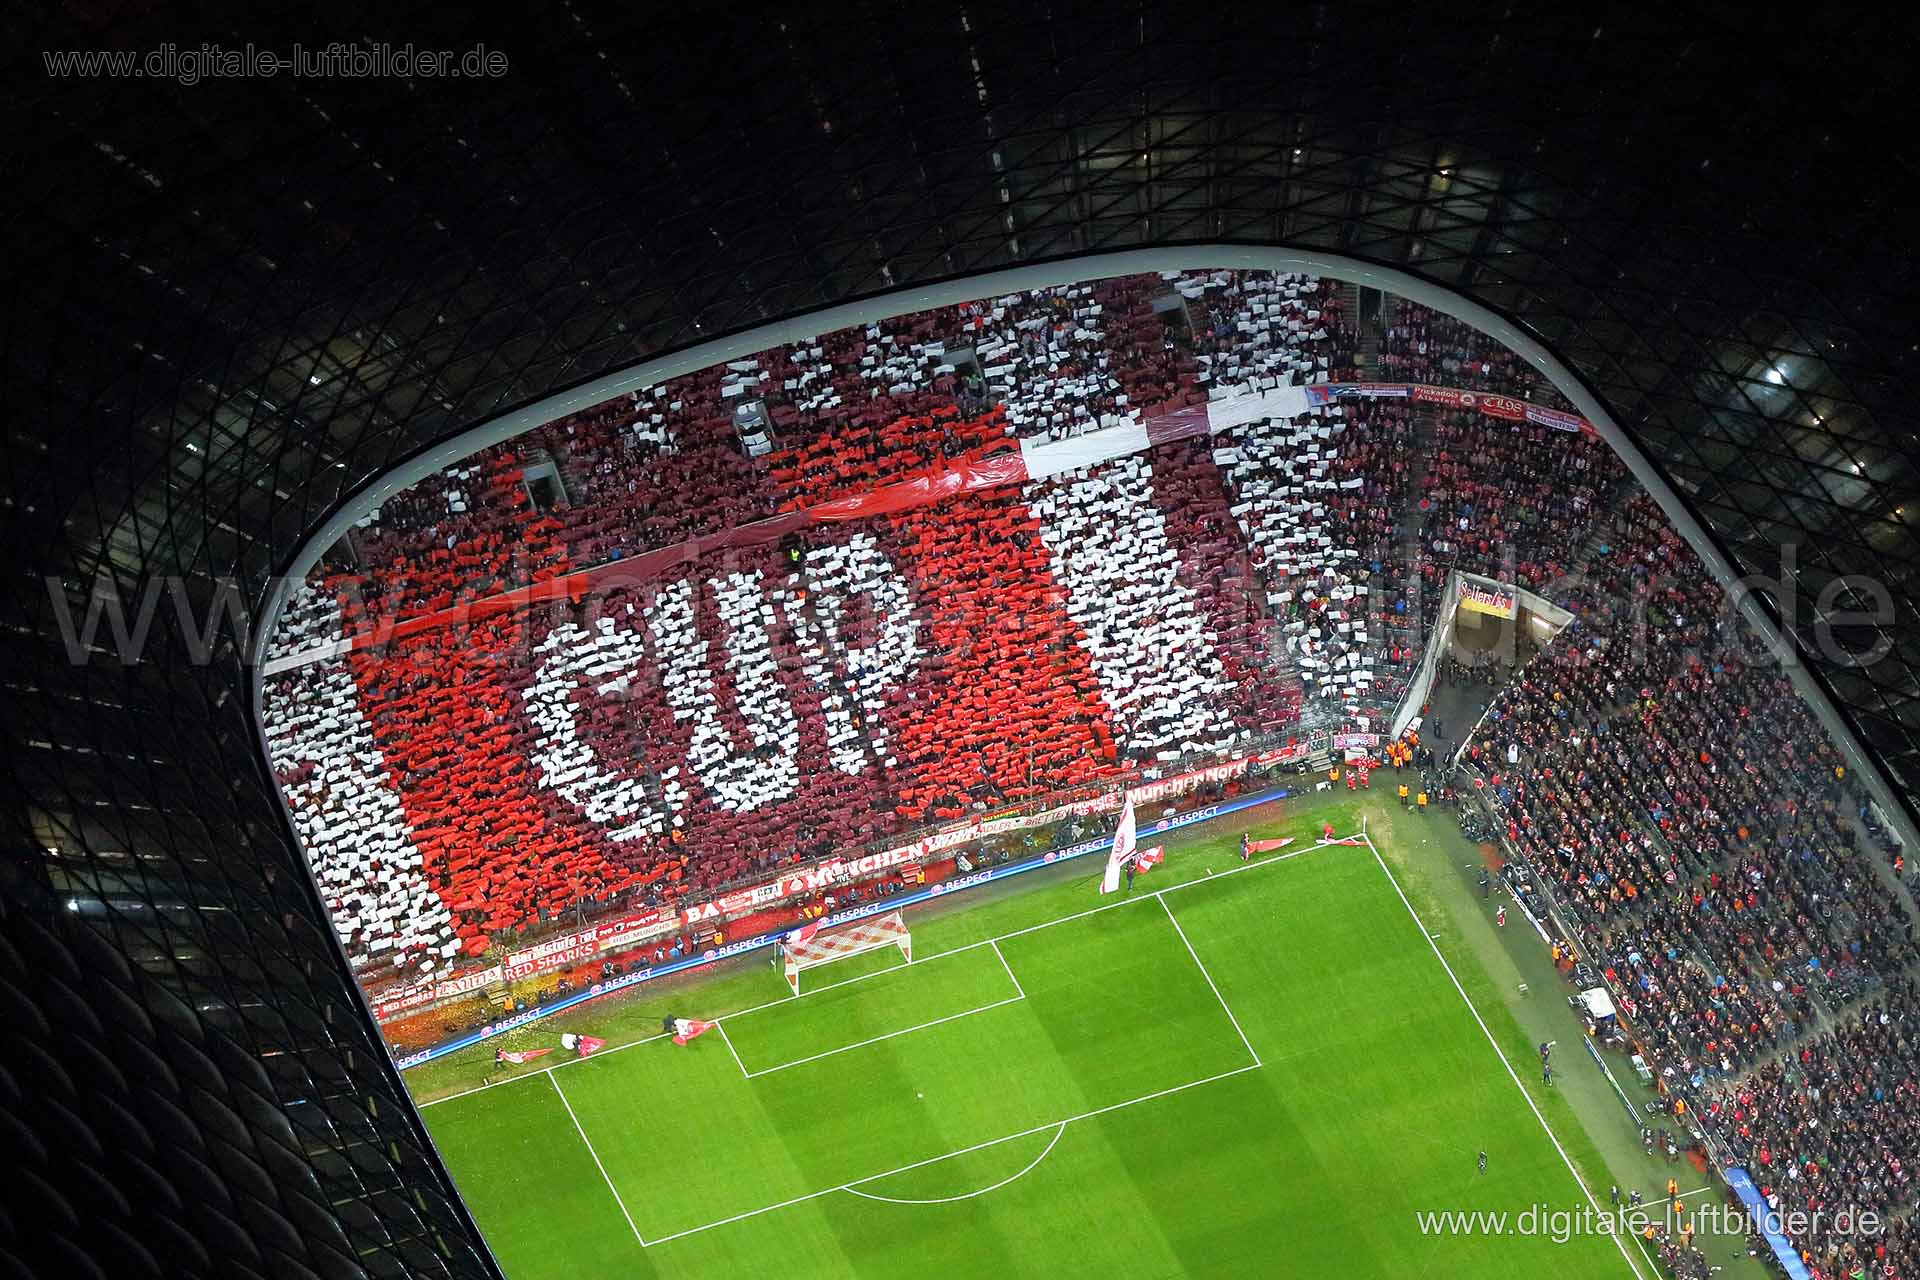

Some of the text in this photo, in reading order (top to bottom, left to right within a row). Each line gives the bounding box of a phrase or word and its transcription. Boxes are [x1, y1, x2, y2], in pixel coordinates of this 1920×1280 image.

[1172, 805, 1219, 826] RESPECT
[1060, 837, 1107, 858] RESPECT
[946, 870, 994, 890] RESPECT
[832, 902, 881, 923] RESPECT
[719, 934, 768, 956] RESPECT
[504, 963, 534, 982] RED
[537, 943, 595, 971] SHARKS
[605, 968, 653, 991] RESPECT
[382, 1003, 400, 1013] RED
[401, 990, 434, 1007] COBRAS
[495, 1007, 542, 1031] RESPECT
